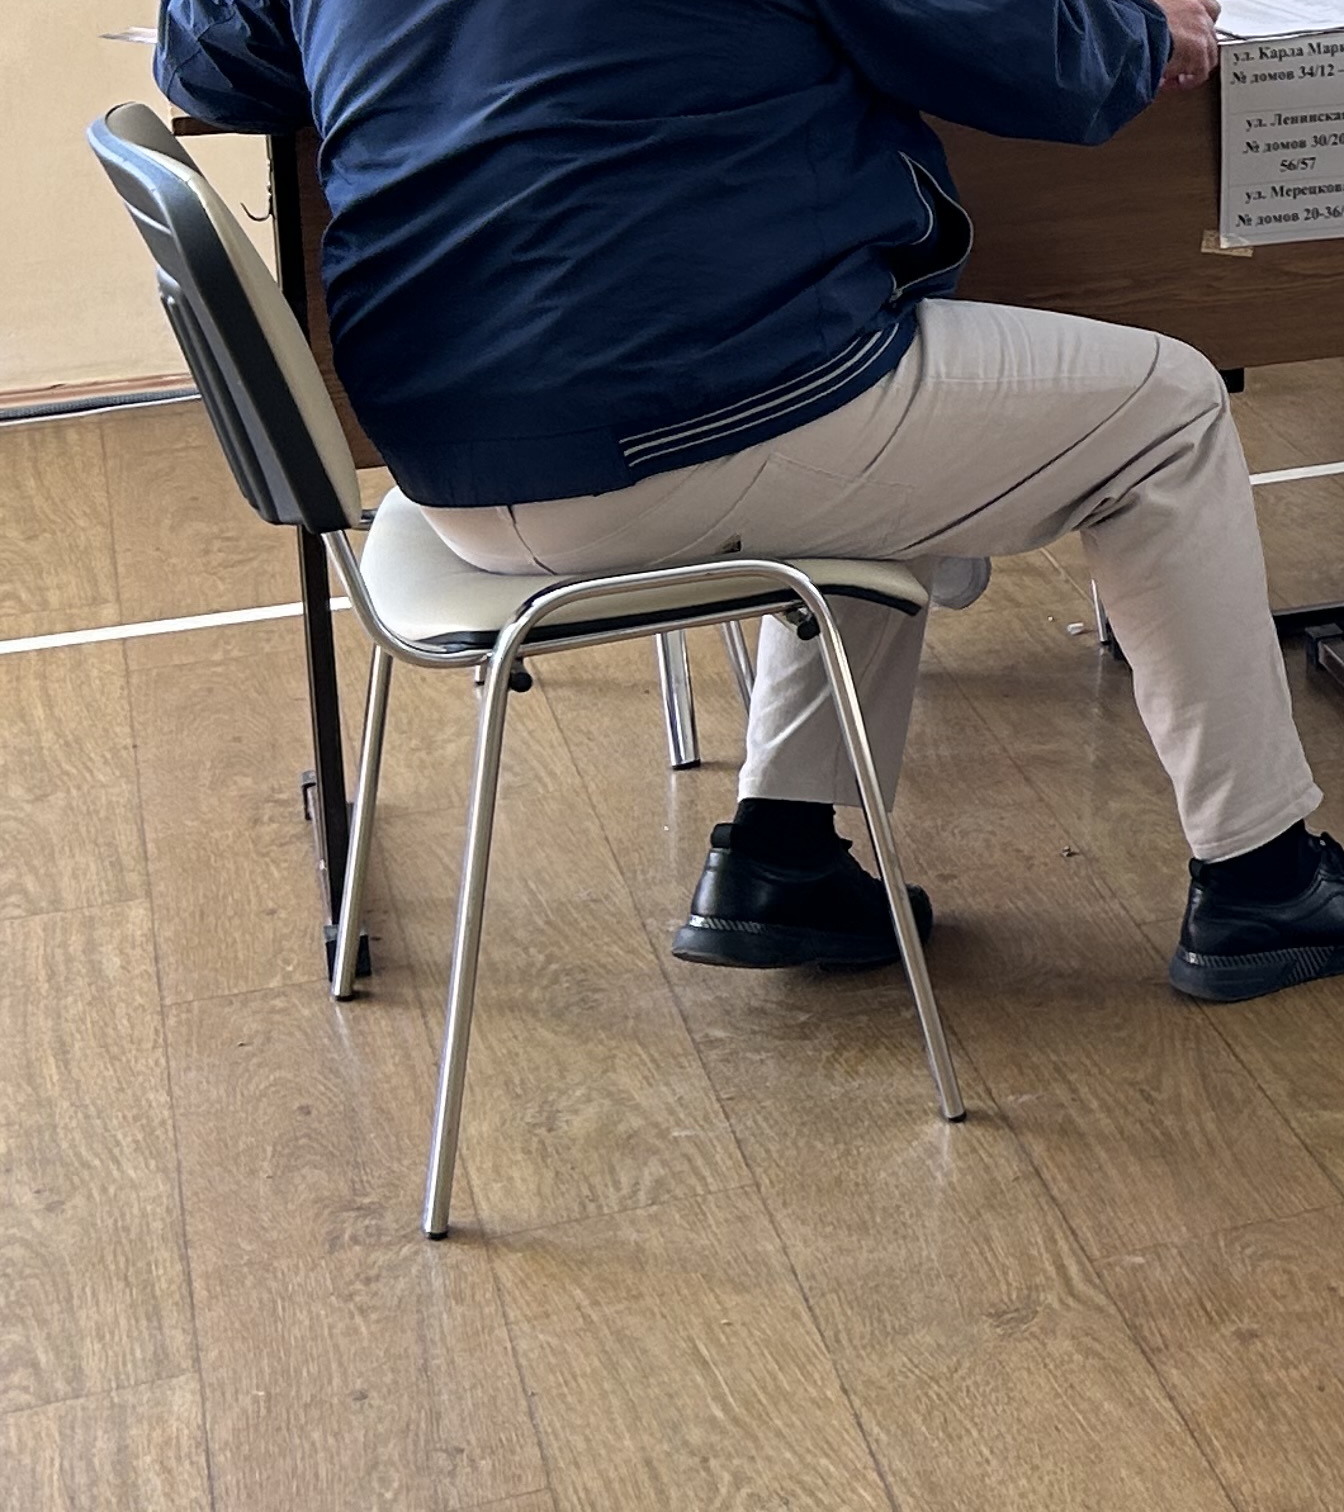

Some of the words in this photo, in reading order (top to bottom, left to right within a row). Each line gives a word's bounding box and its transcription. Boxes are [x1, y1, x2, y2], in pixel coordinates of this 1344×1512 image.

[1232, 52, 1254, 66] ул.
[1258, 45, 1304, 62] Карла
[1230, 70, 1247, 85] №
[1250, 70, 1295, 84] домов
[1298, 63, 1335, 79] 34/12
[1245, 118, 1267, 133] ул.
[1242, 140, 1260, 154] №
[1262, 139, 1307, 153] домов
[1279, 156, 1317, 173] 56/57
[1245, 191, 1267, 204] ул.
[1235, 213, 1253, 228] №
[1255, 211, 1300, 226] домов
